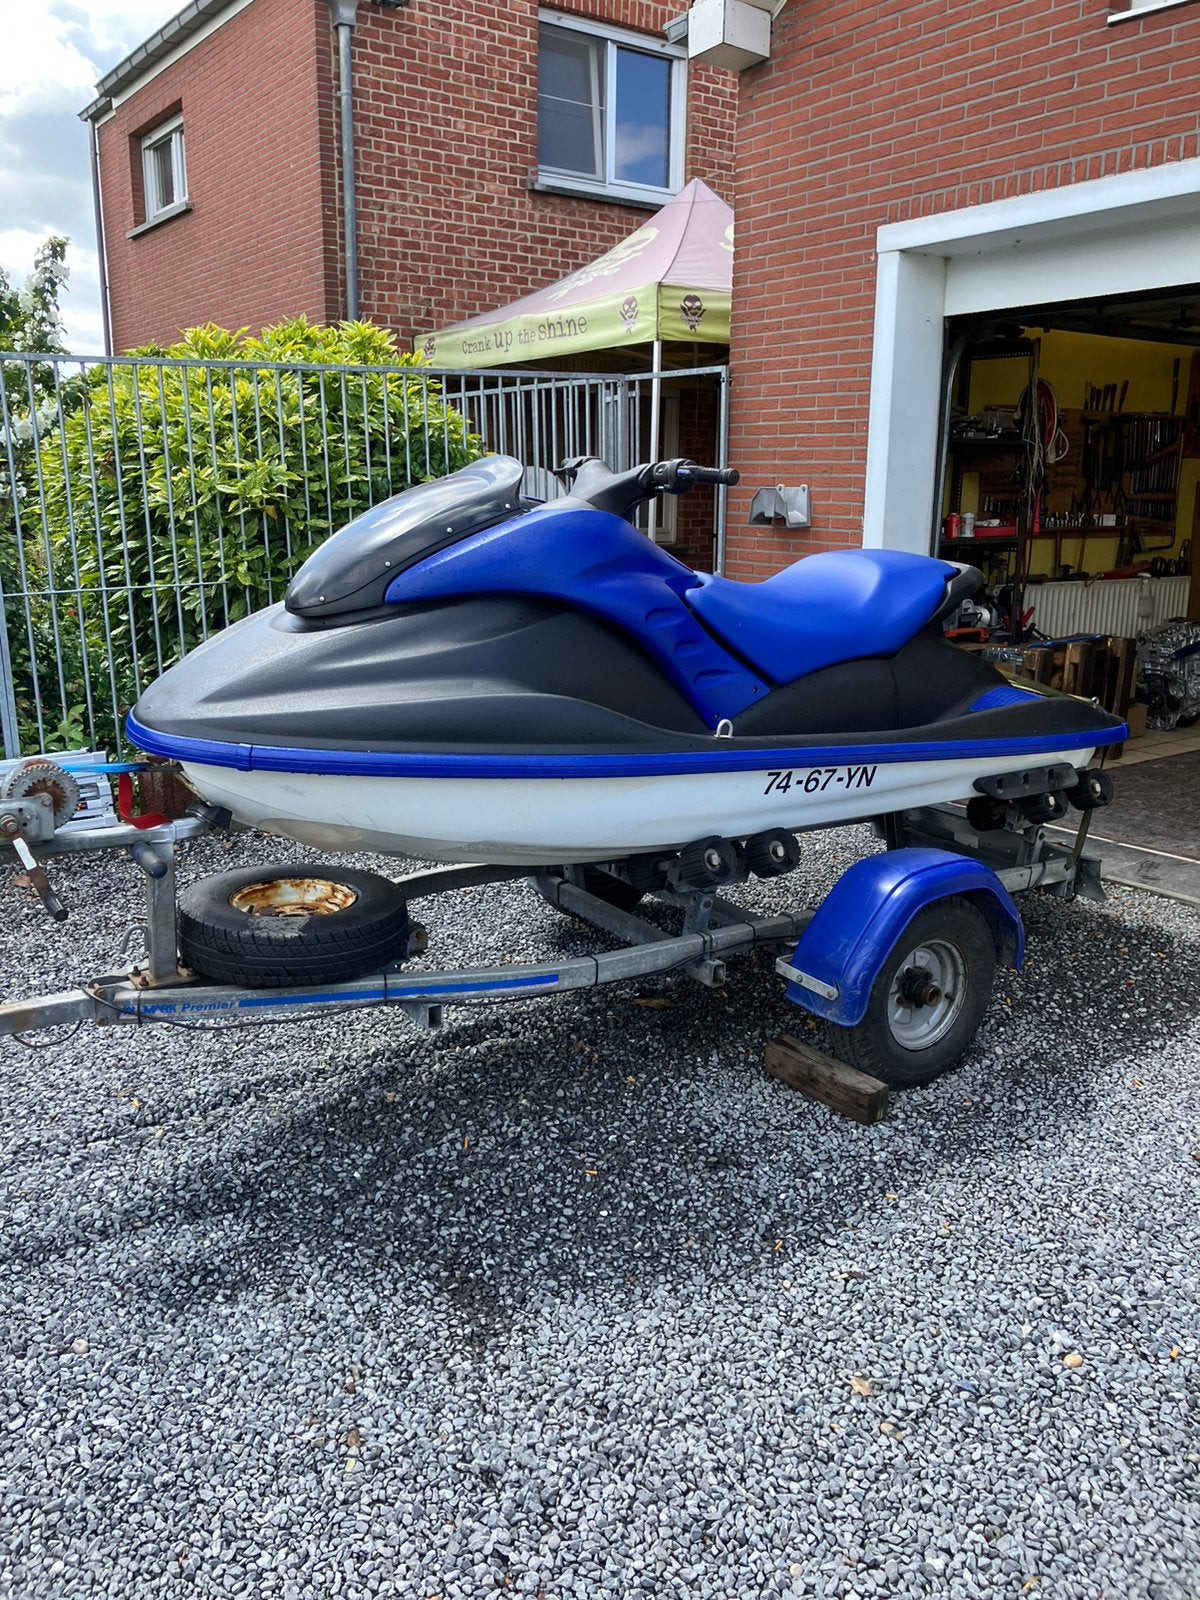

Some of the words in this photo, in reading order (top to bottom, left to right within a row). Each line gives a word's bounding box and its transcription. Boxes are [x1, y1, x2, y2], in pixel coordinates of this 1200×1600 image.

[462, 336, 491, 354] Crank
[494, 330, 513, 353] up
[518, 329, 536, 345] the
[538, 315, 588, 341] shine
[763, 766, 878, 795] 74-67-YN
[181, 1001, 234, 1013] Premier
